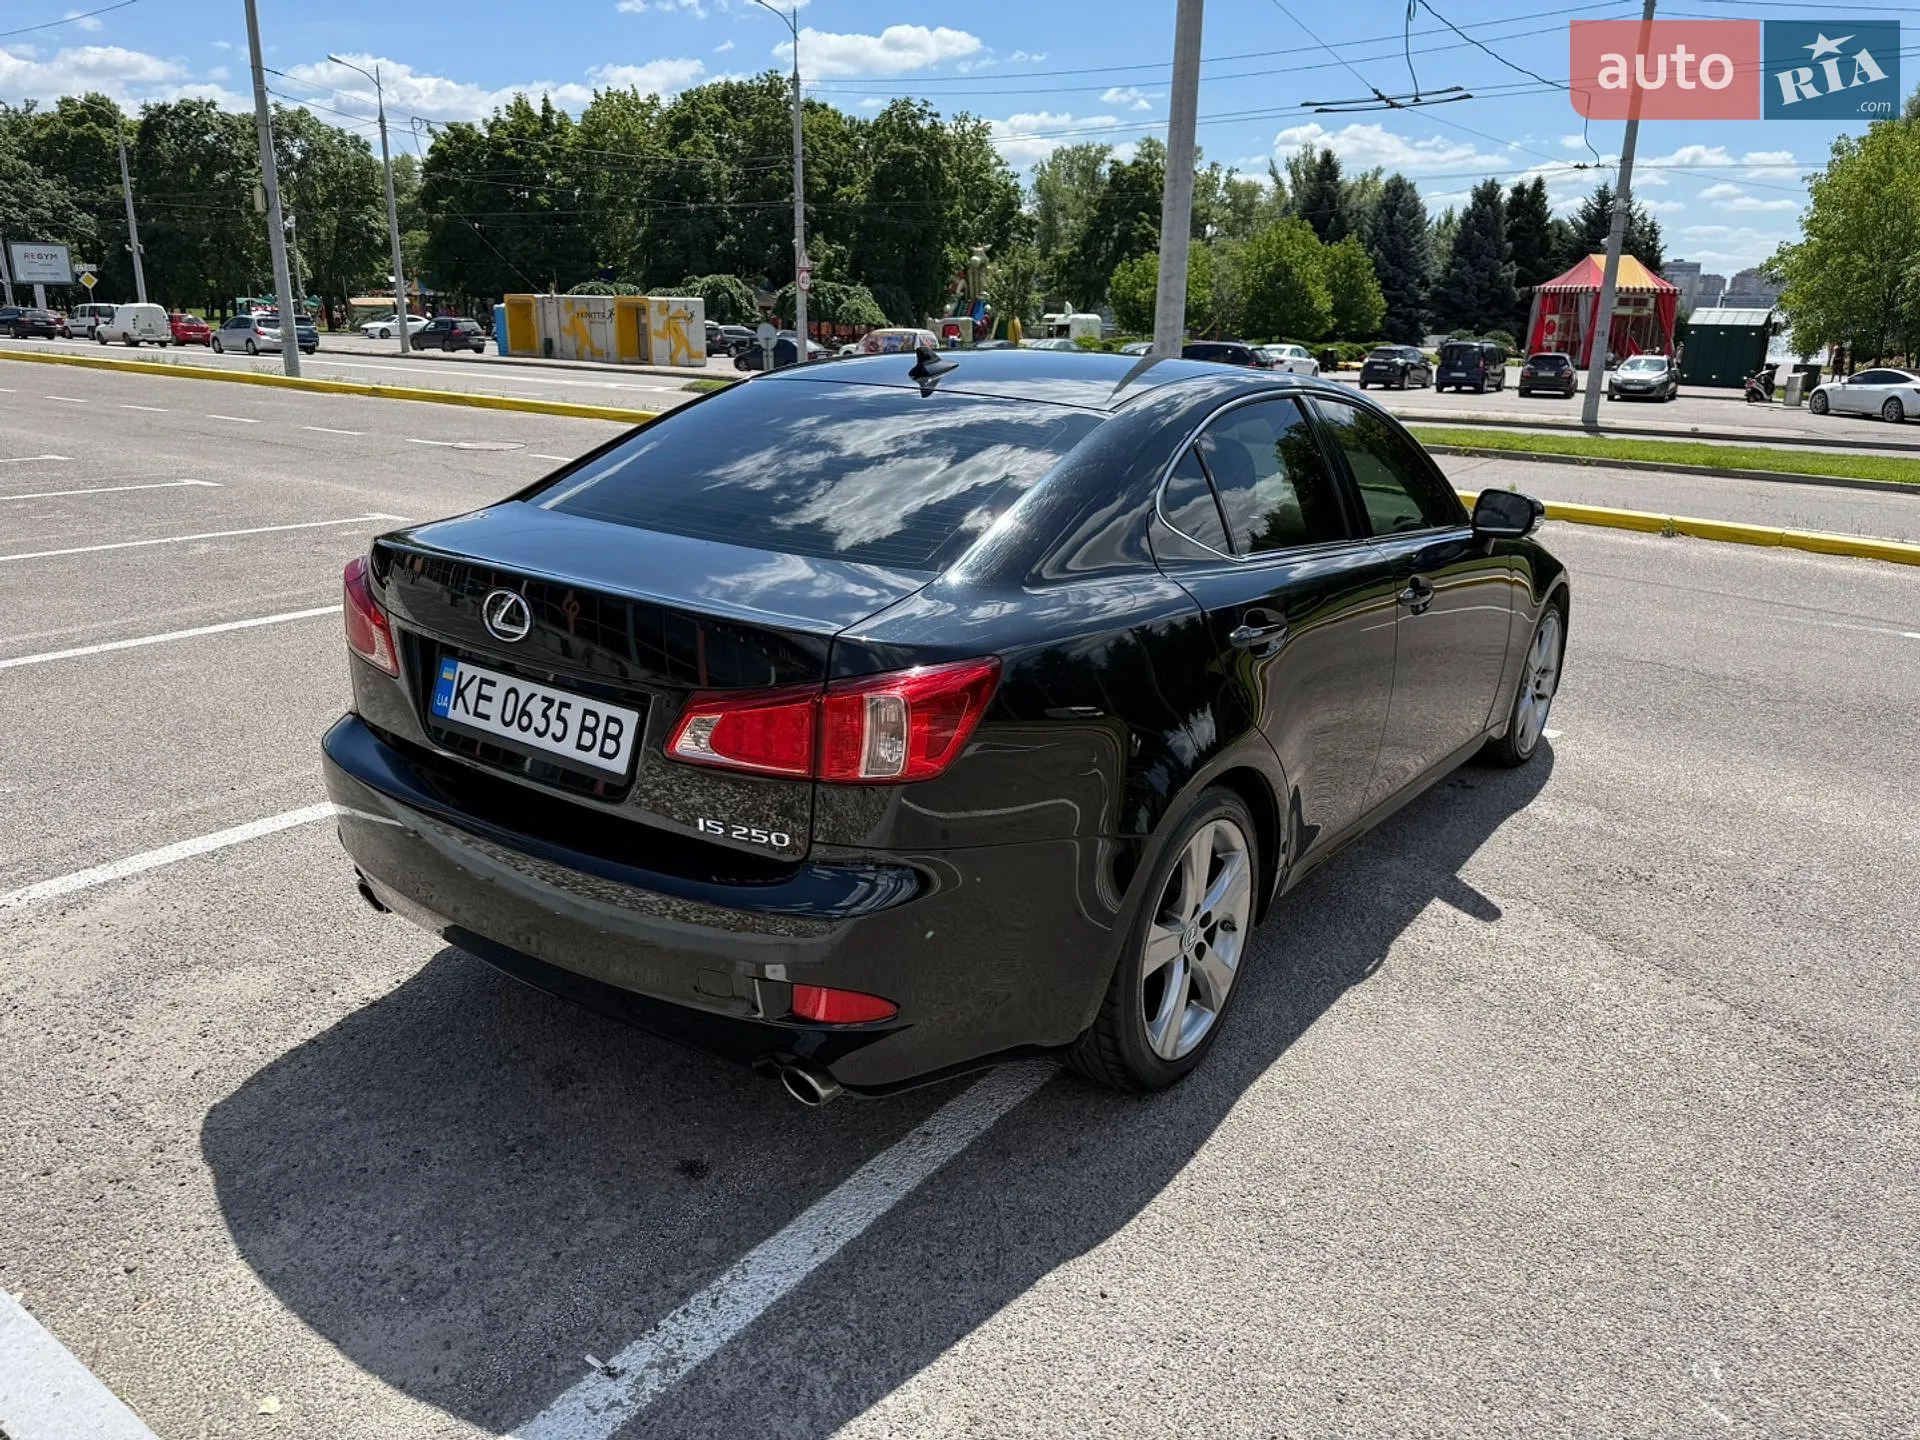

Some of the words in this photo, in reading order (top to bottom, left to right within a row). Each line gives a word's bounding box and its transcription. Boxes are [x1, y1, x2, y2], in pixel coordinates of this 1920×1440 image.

[437, 693, 448, 708] UA
[452, 671, 497, 721] KE
[501, 687, 571, 743] 0635
[576, 708, 624, 760] BB
[698, 817, 725, 835] IS
[731, 824, 791, 847] 250
